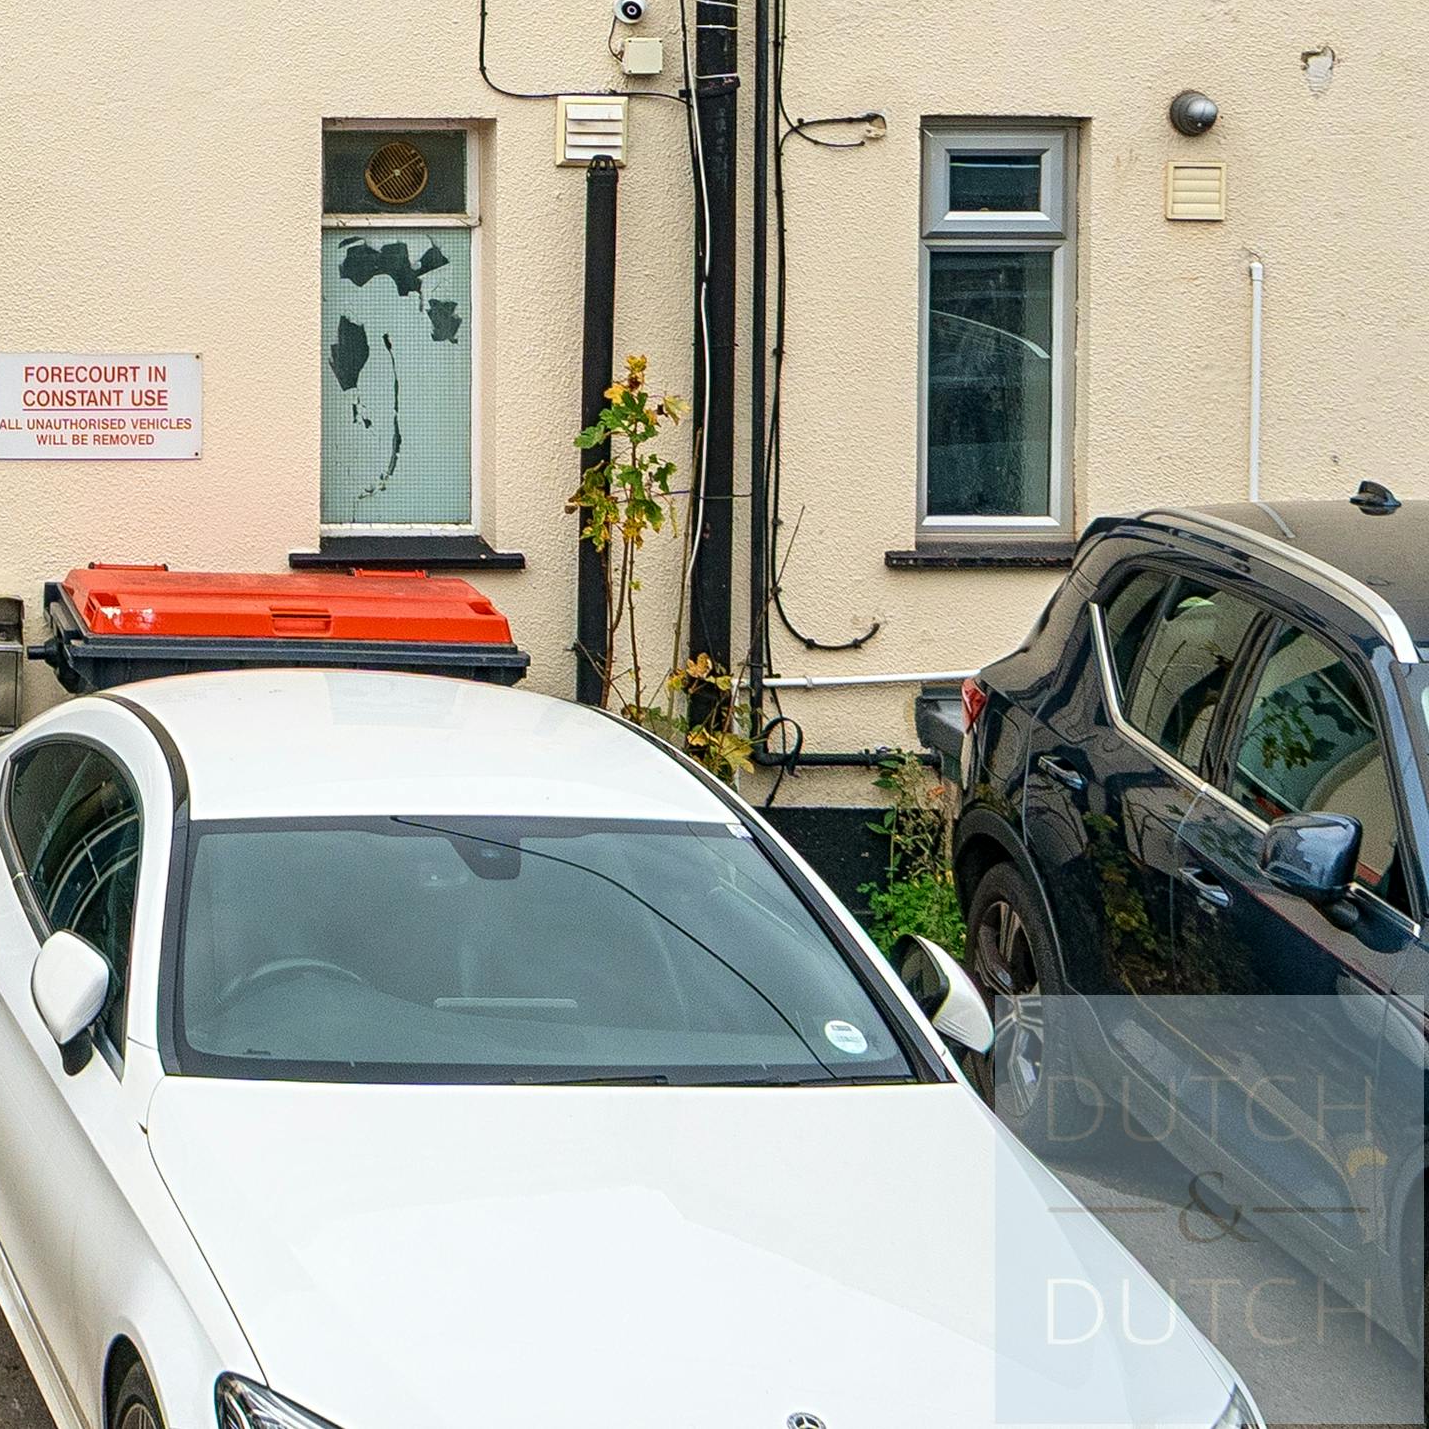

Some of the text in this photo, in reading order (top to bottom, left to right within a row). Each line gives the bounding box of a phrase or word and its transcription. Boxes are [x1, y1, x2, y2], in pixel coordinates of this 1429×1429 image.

[25, 366, 167, 383] FORECOURT IN
[23, 390, 168, 407] CONSTANT USE
[0, 418, 191, 430] ALL UNAUTHORISED VEHICLES
[37, 434, 154, 445] WILL BE REMOVED
